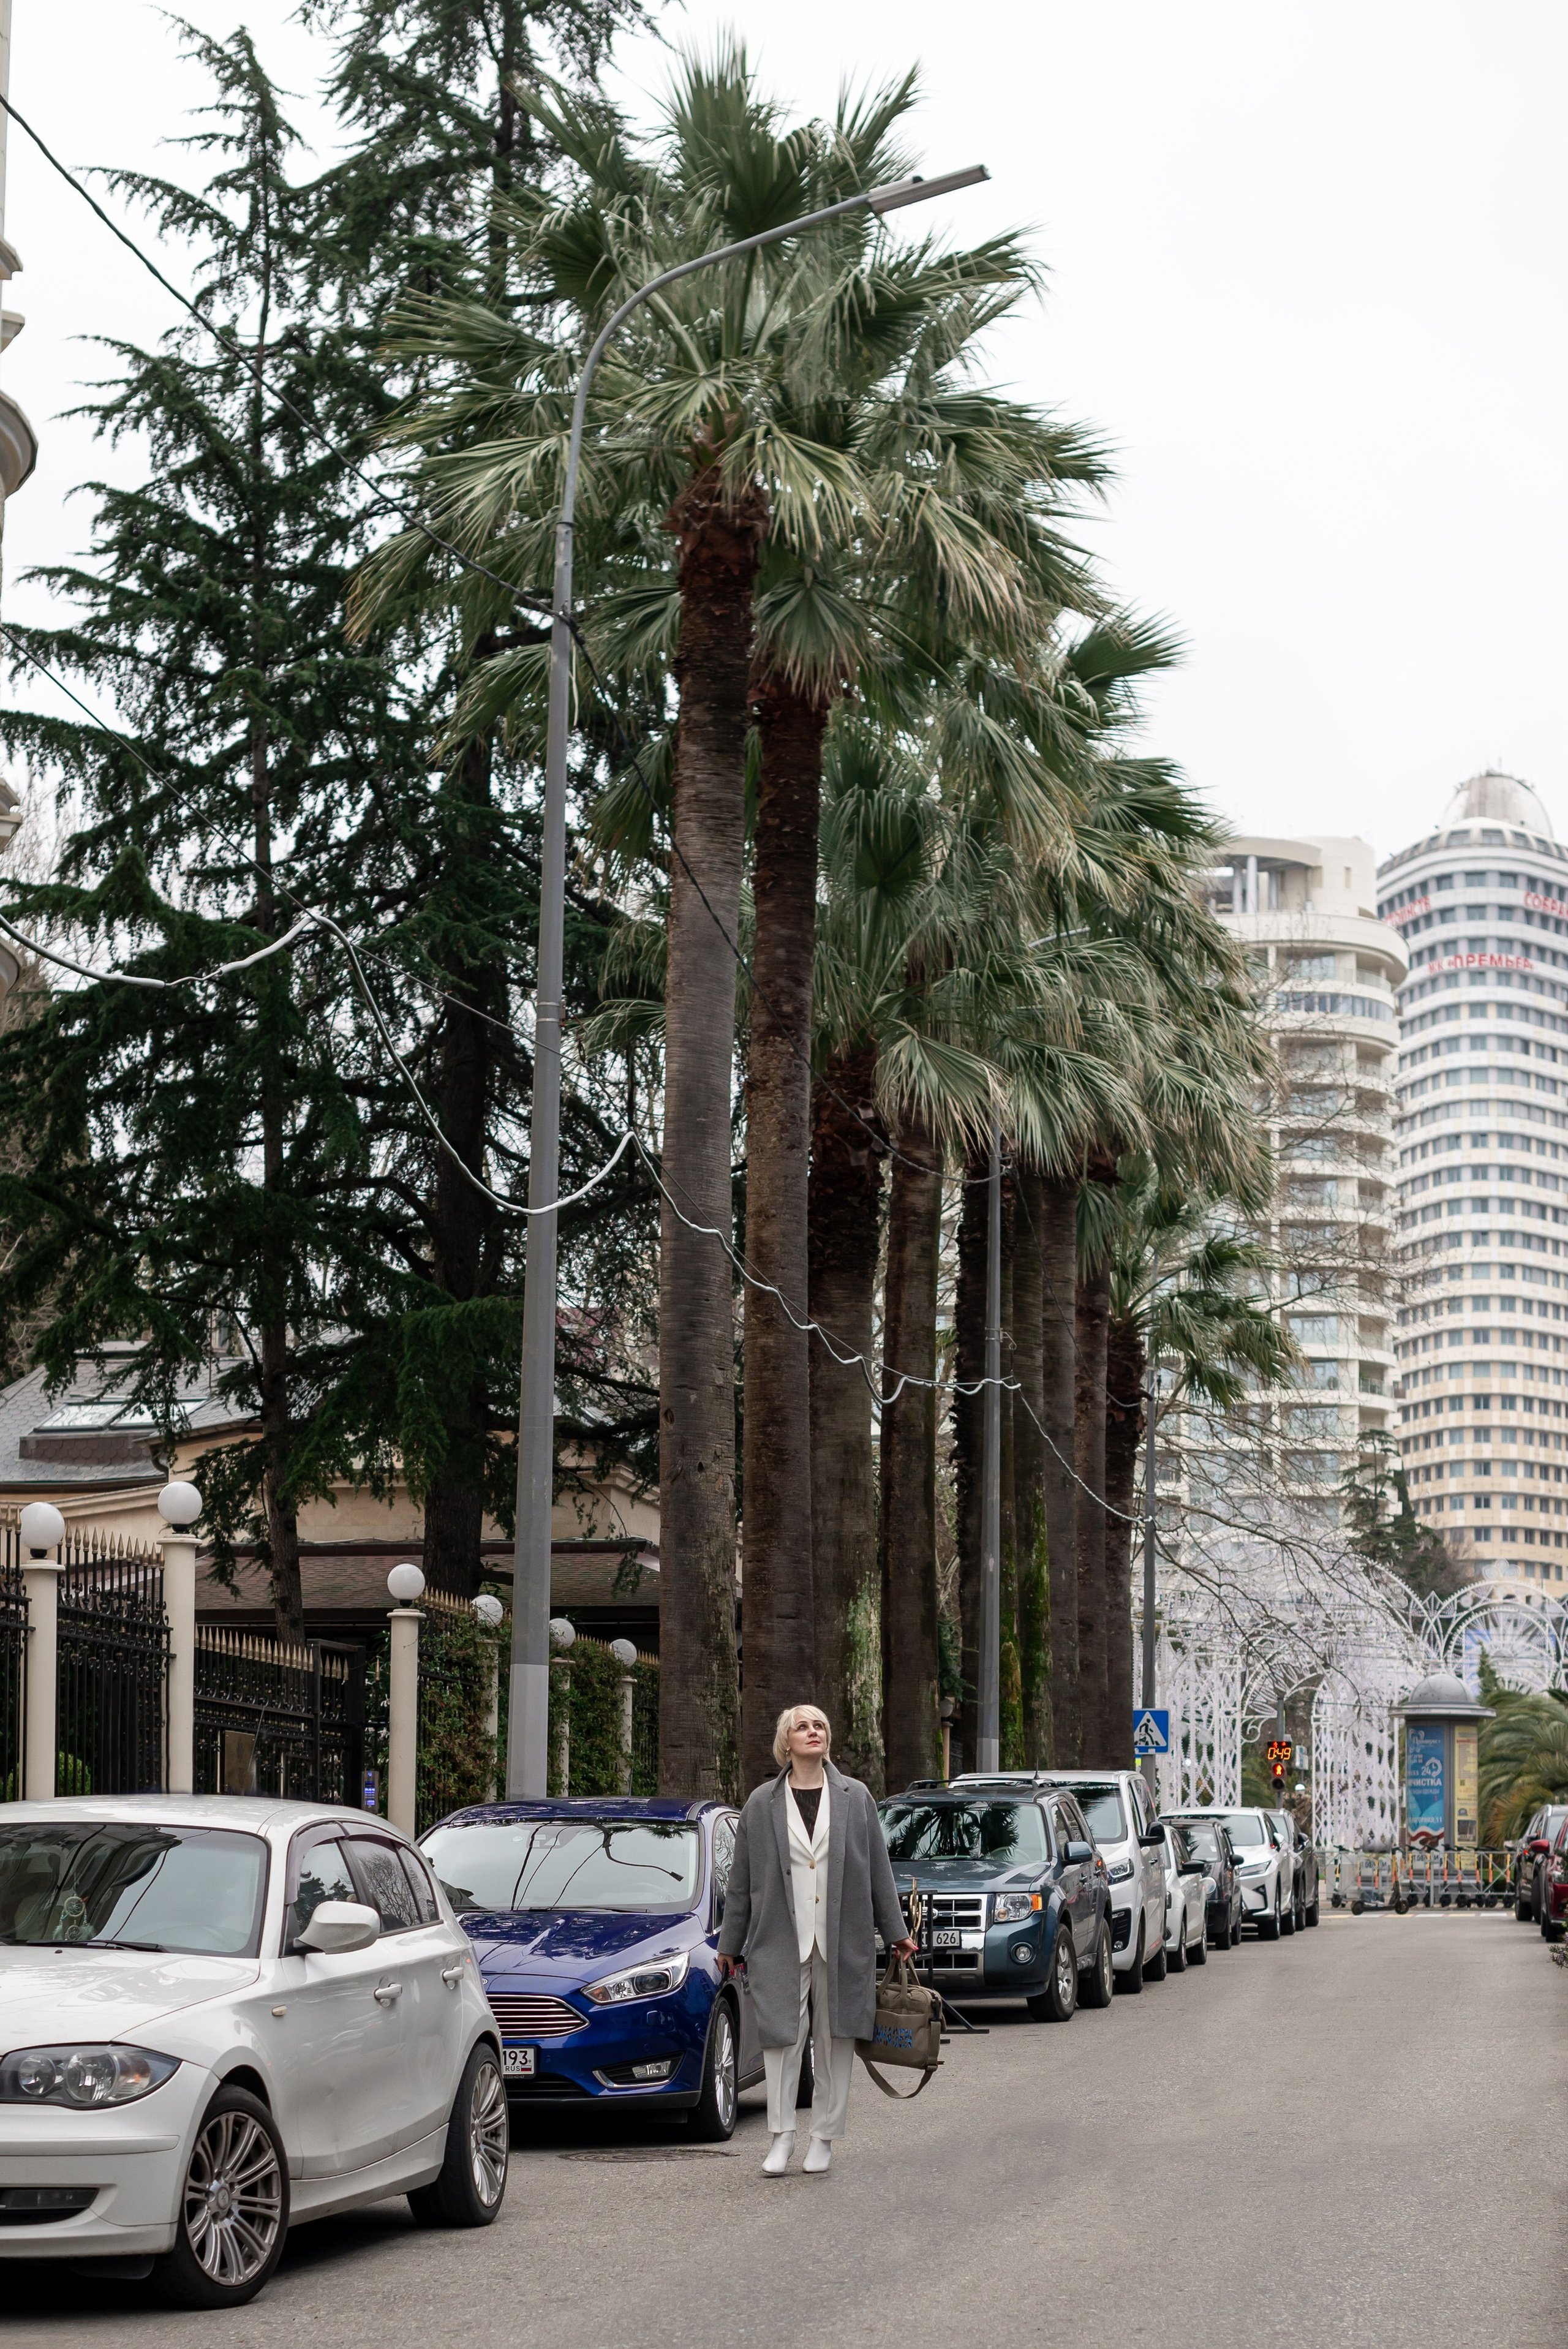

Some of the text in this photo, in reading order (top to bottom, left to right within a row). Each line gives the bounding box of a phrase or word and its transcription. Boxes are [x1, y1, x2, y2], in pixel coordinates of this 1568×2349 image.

[1267, 1747, 1292, 1760] 0:49
[1422, 1766, 1431, 1776] 24
[937, 1932, 956, 1945] 626
[503, 2050, 528, 2065] 193
